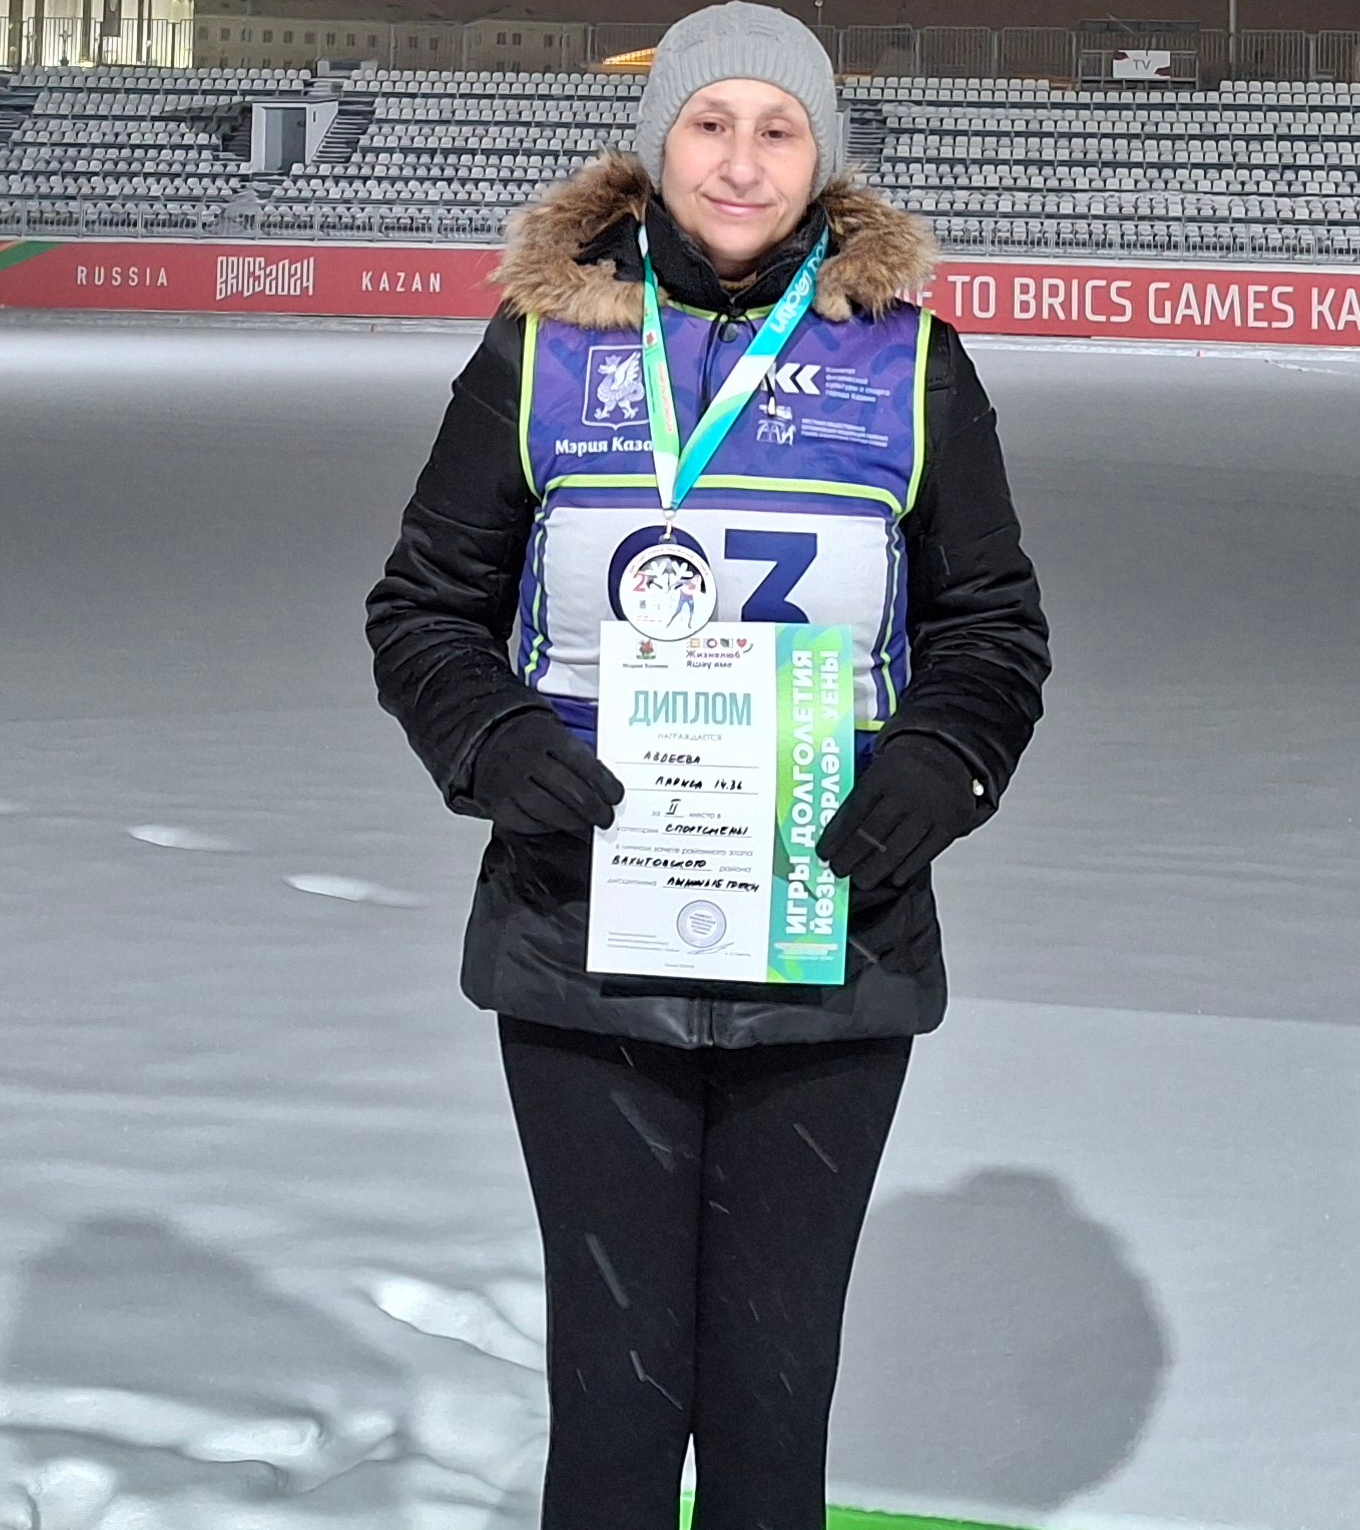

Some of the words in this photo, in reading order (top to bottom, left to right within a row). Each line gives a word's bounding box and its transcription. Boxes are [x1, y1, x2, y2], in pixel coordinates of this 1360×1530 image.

[1132, 59, 1151, 70] TV
[77, 265, 168, 286] RUSSIA
[361, 271, 441, 293] KAZAN
[947, 275, 996, 319] TO
[1013, 277, 1133, 322] BRICS
[1148, 282, 1294, 329] GAMES
[555, 439, 608, 457] Мэрия
[612, 436, 653, 452] Каза
[820, 650, 840, 720] УЕНЫ
[628, 690, 751, 726] ДИПЛОМ
[791, 650, 816, 848] ДОЛГОЛЕТИЯ
[786, 855, 810, 934] ИГРЫ
